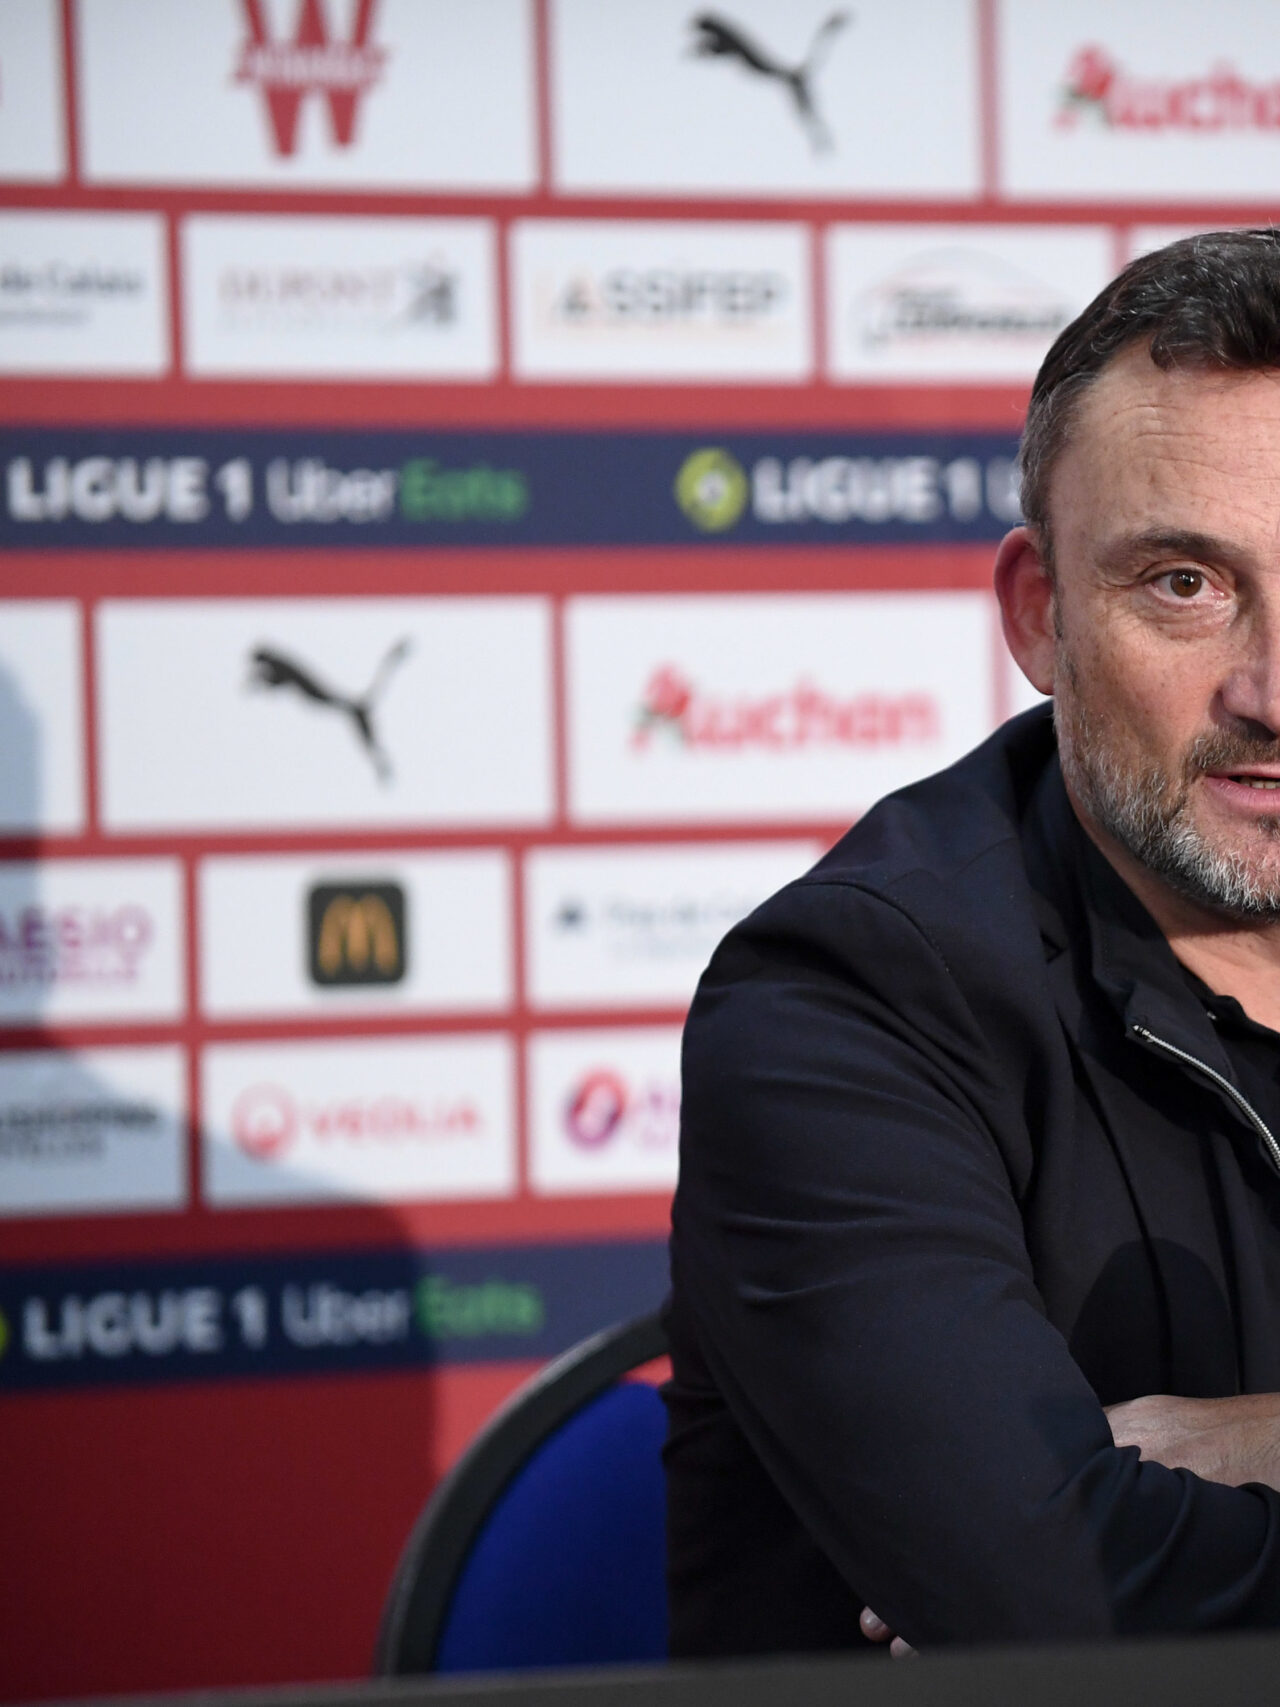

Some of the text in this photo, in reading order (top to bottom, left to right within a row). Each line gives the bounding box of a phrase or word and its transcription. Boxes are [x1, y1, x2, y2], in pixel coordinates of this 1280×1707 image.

[8, 457, 528, 522] LIGUE 1 Uber Eats
[753, 456, 942, 523] LIGUE
[948, 458, 982, 522] 1
[24, 1275, 545, 1360] LIGUE 1 Uber Eats
